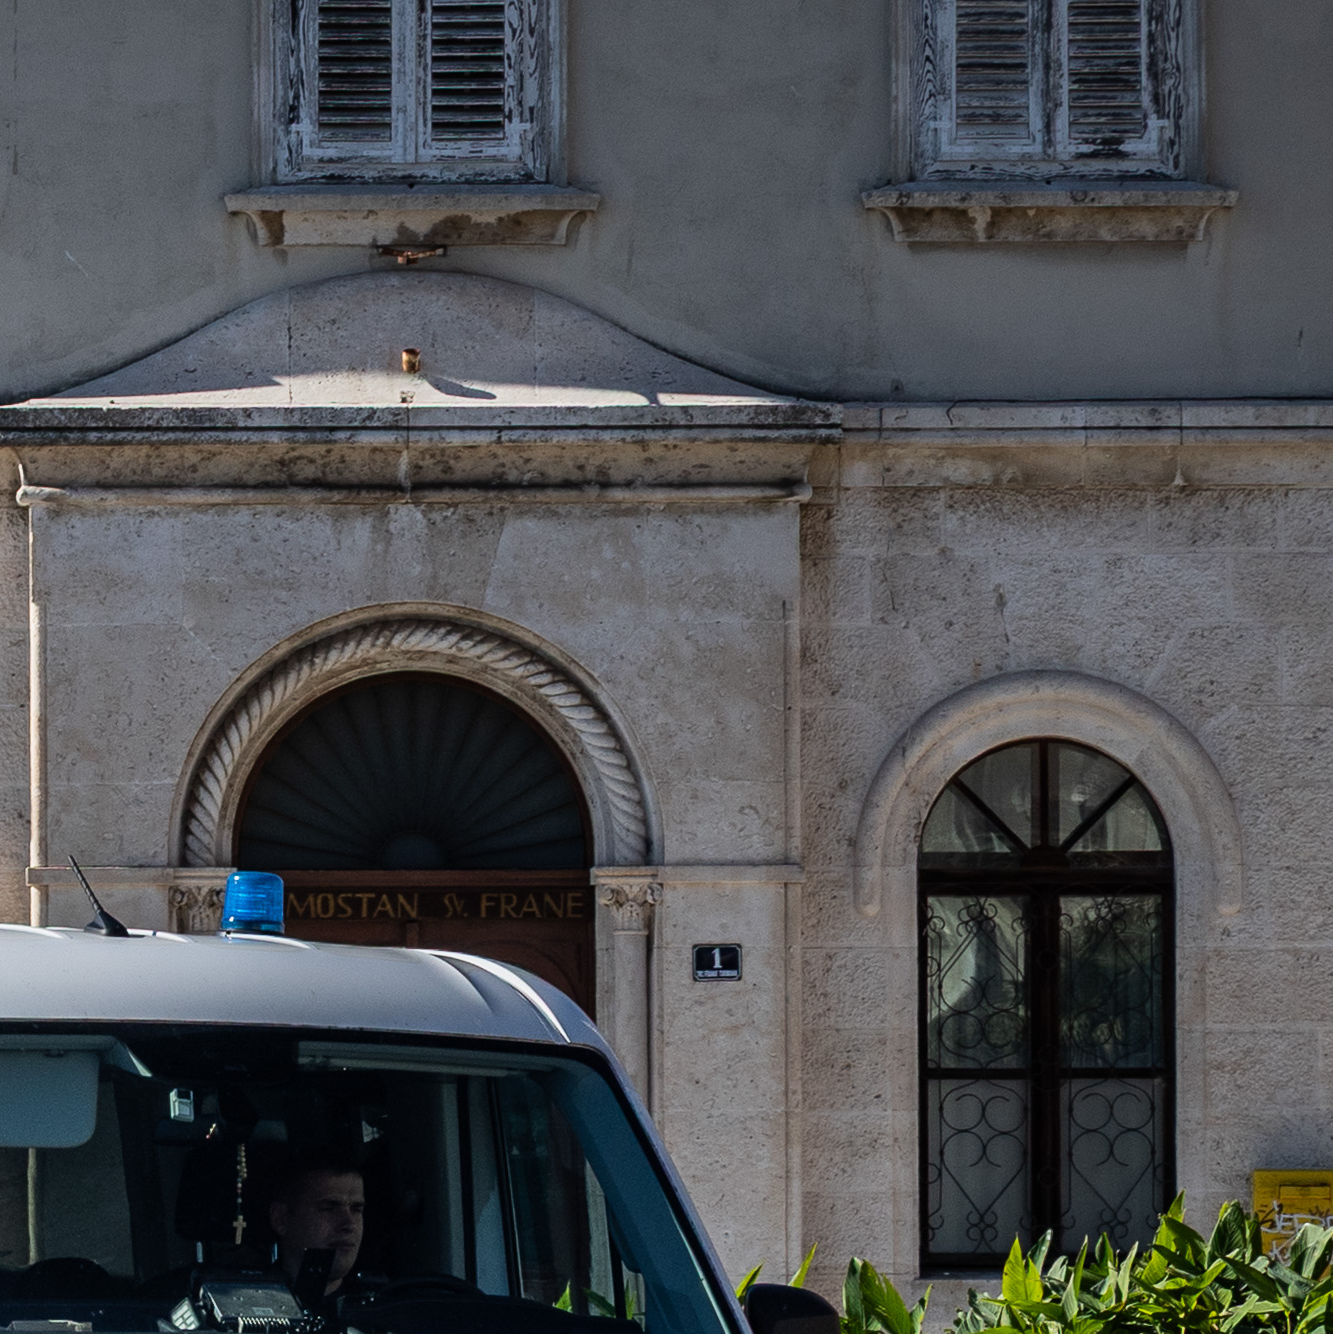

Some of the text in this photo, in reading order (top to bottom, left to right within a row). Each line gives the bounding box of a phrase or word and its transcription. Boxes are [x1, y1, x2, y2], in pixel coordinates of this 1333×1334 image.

[286, 893, 419, 918] MOSTAN
[480, 893, 583, 918] FRANE
[711, 947, 723, 969] 1
